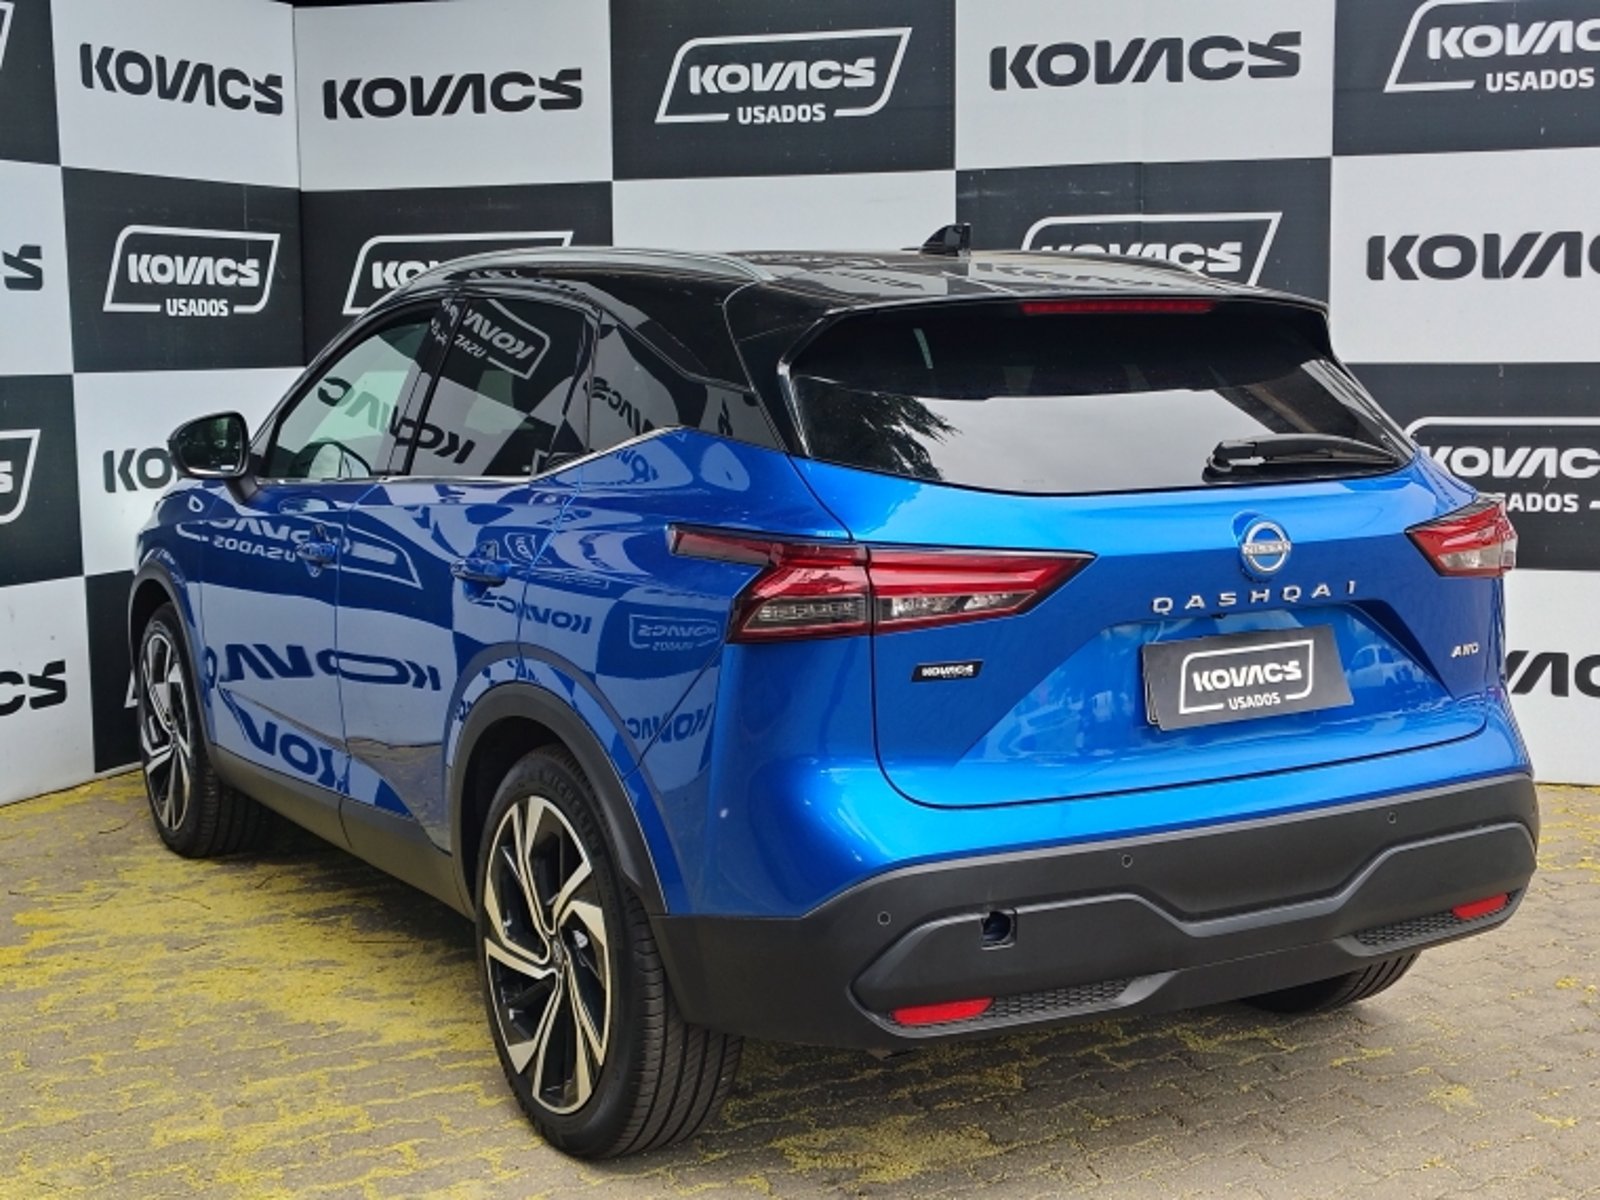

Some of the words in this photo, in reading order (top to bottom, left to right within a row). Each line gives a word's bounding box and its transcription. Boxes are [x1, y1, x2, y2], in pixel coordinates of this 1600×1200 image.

[689, 57, 875, 94] KOVACS
[989, 31, 1301, 90] KOVACS
[80, 43, 283, 115] KOVACS
[323, 68, 582, 119] KOVACS
[1485, 67, 1595, 92] USADOS
[737, 104, 826, 124] USADOS
[128, 254, 259, 287] KOVACS
[1367, 232, 1600, 280] KOVA
[166, 298, 228, 317] USADOS
[1153, 580, 1355, 615] QASHQAI
[1192, 660, 1302, 692] KOVACS
[1229, 692, 1280, 710] USADOS
